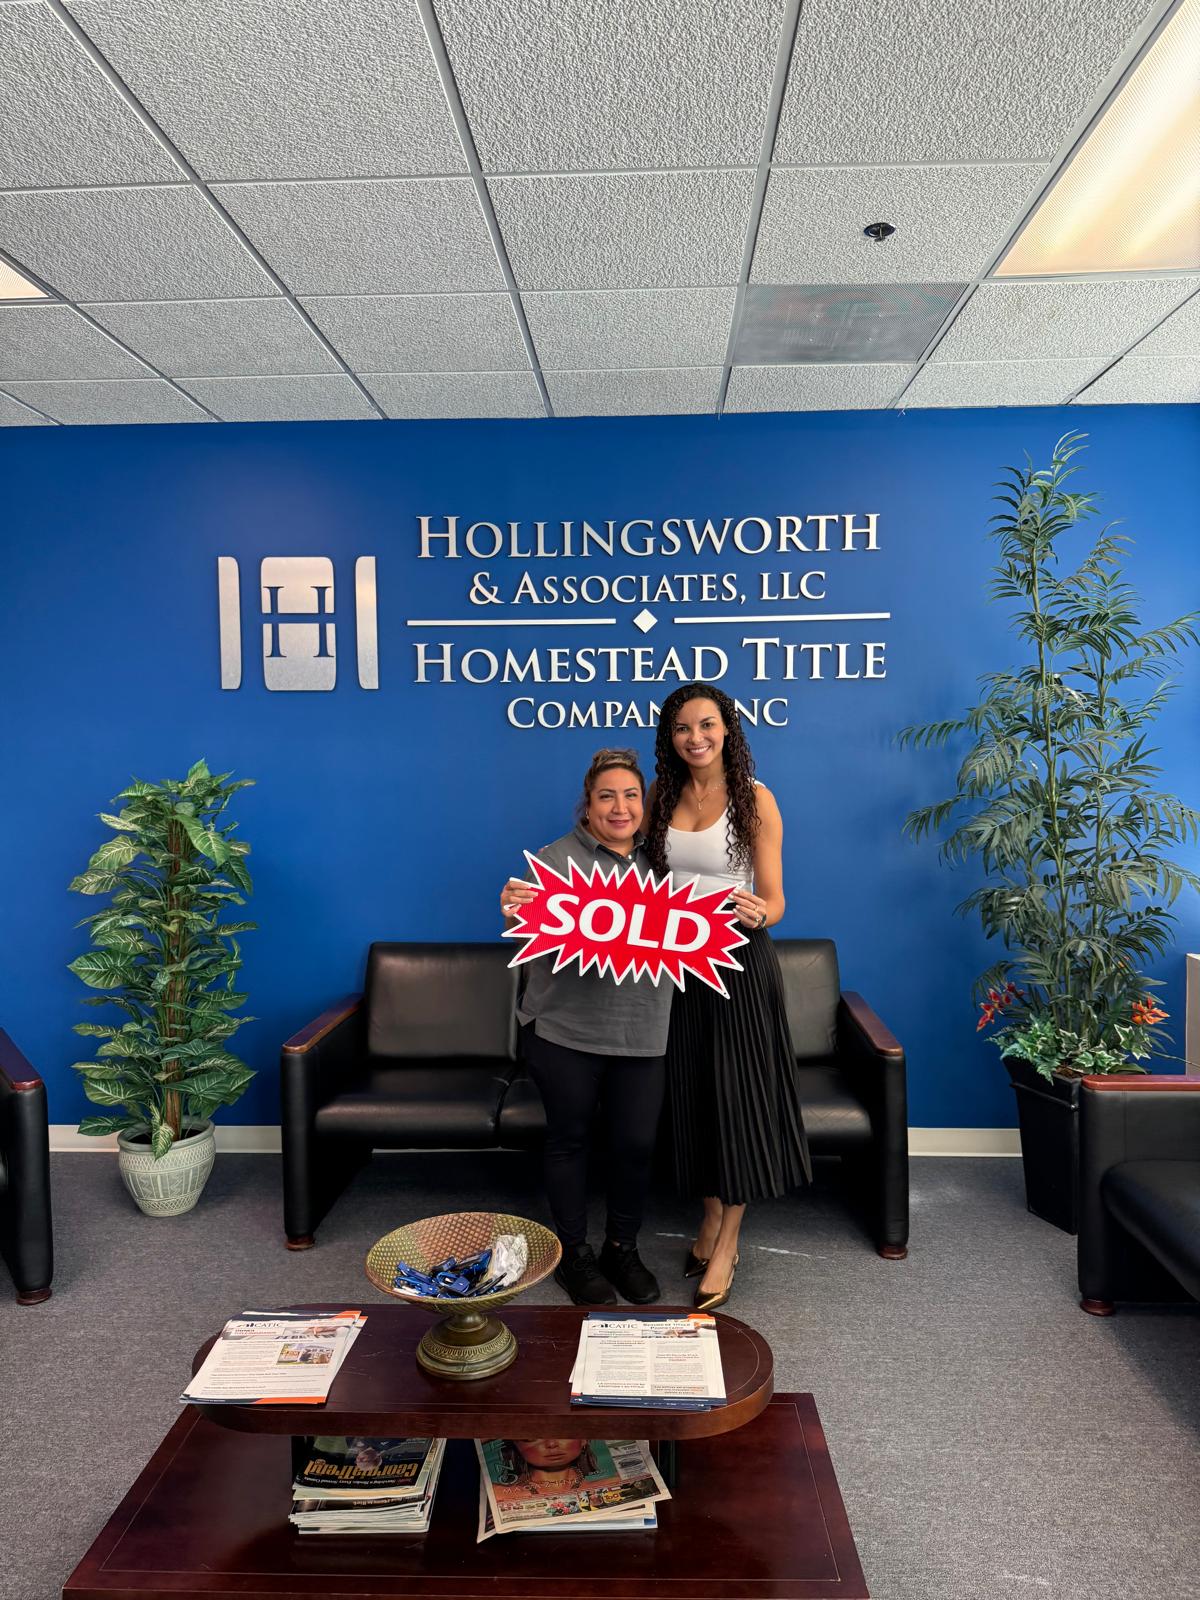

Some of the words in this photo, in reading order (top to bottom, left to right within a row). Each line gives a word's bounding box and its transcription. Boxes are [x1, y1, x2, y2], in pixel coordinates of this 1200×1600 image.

[416, 513, 881, 559] HOLLINGSWORTH
[469, 571, 505, 605] &
[511, 571, 746, 605] ASSOCIATES,
[760, 570, 826, 601] LLC
[413, 643, 729, 684] HOMESTEAD
[741, 637, 887, 681] TITLE
[734, 697, 789, 727] NC
[539, 893, 711, 953] SOLD
